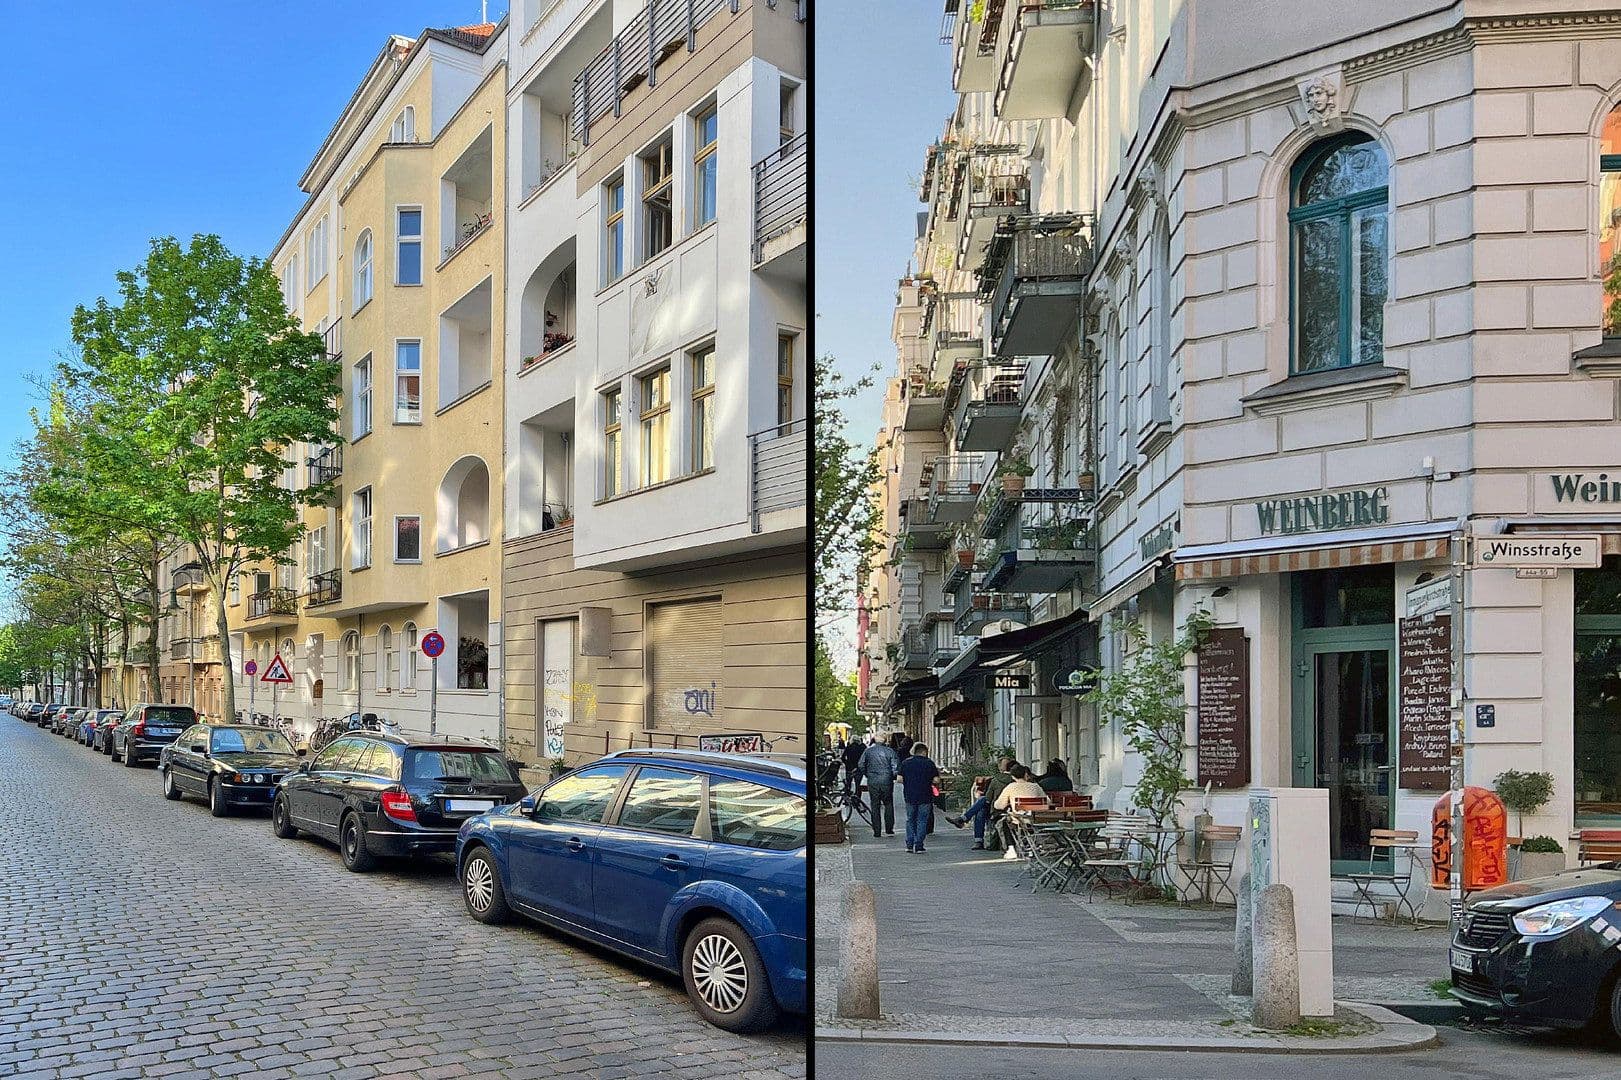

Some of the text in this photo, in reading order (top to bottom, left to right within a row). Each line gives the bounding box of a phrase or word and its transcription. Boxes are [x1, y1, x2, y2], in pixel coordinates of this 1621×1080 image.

[1255, 486, 1389, 536] WEINBERG
[1491, 542, 1582, 559] Winsstraße
[995, 677, 1020, 687] Mia
